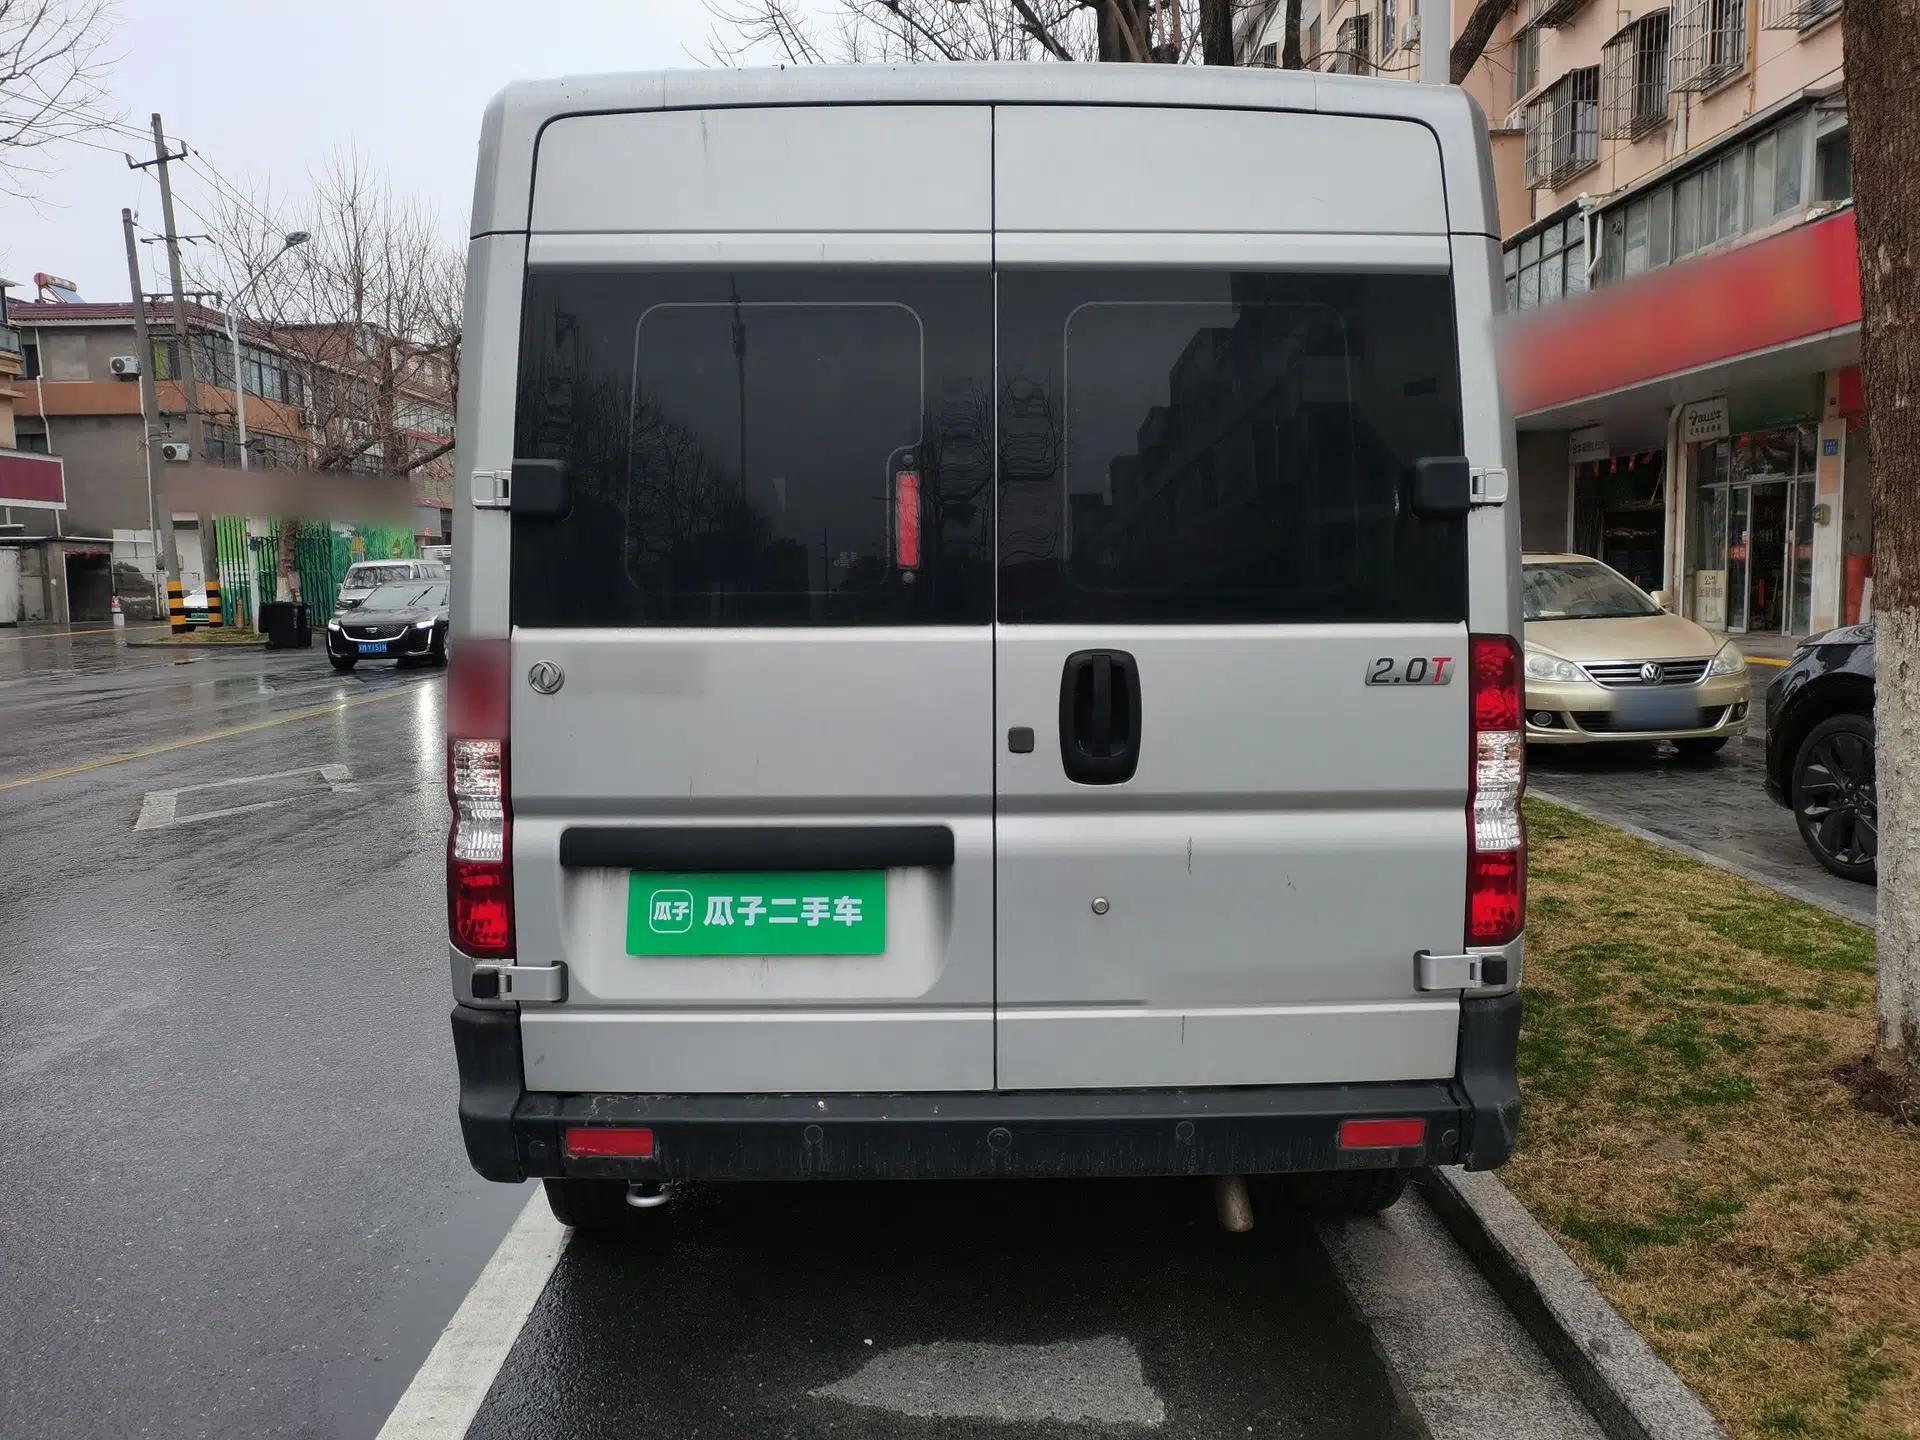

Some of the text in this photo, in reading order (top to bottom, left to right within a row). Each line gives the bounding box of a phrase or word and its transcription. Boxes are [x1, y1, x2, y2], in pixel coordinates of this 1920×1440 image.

[1371, 657, 1453, 683] 2.0T
[653, 901, 690, 921] 瓜子
[704, 896, 863, 927] 瓜子二手车
